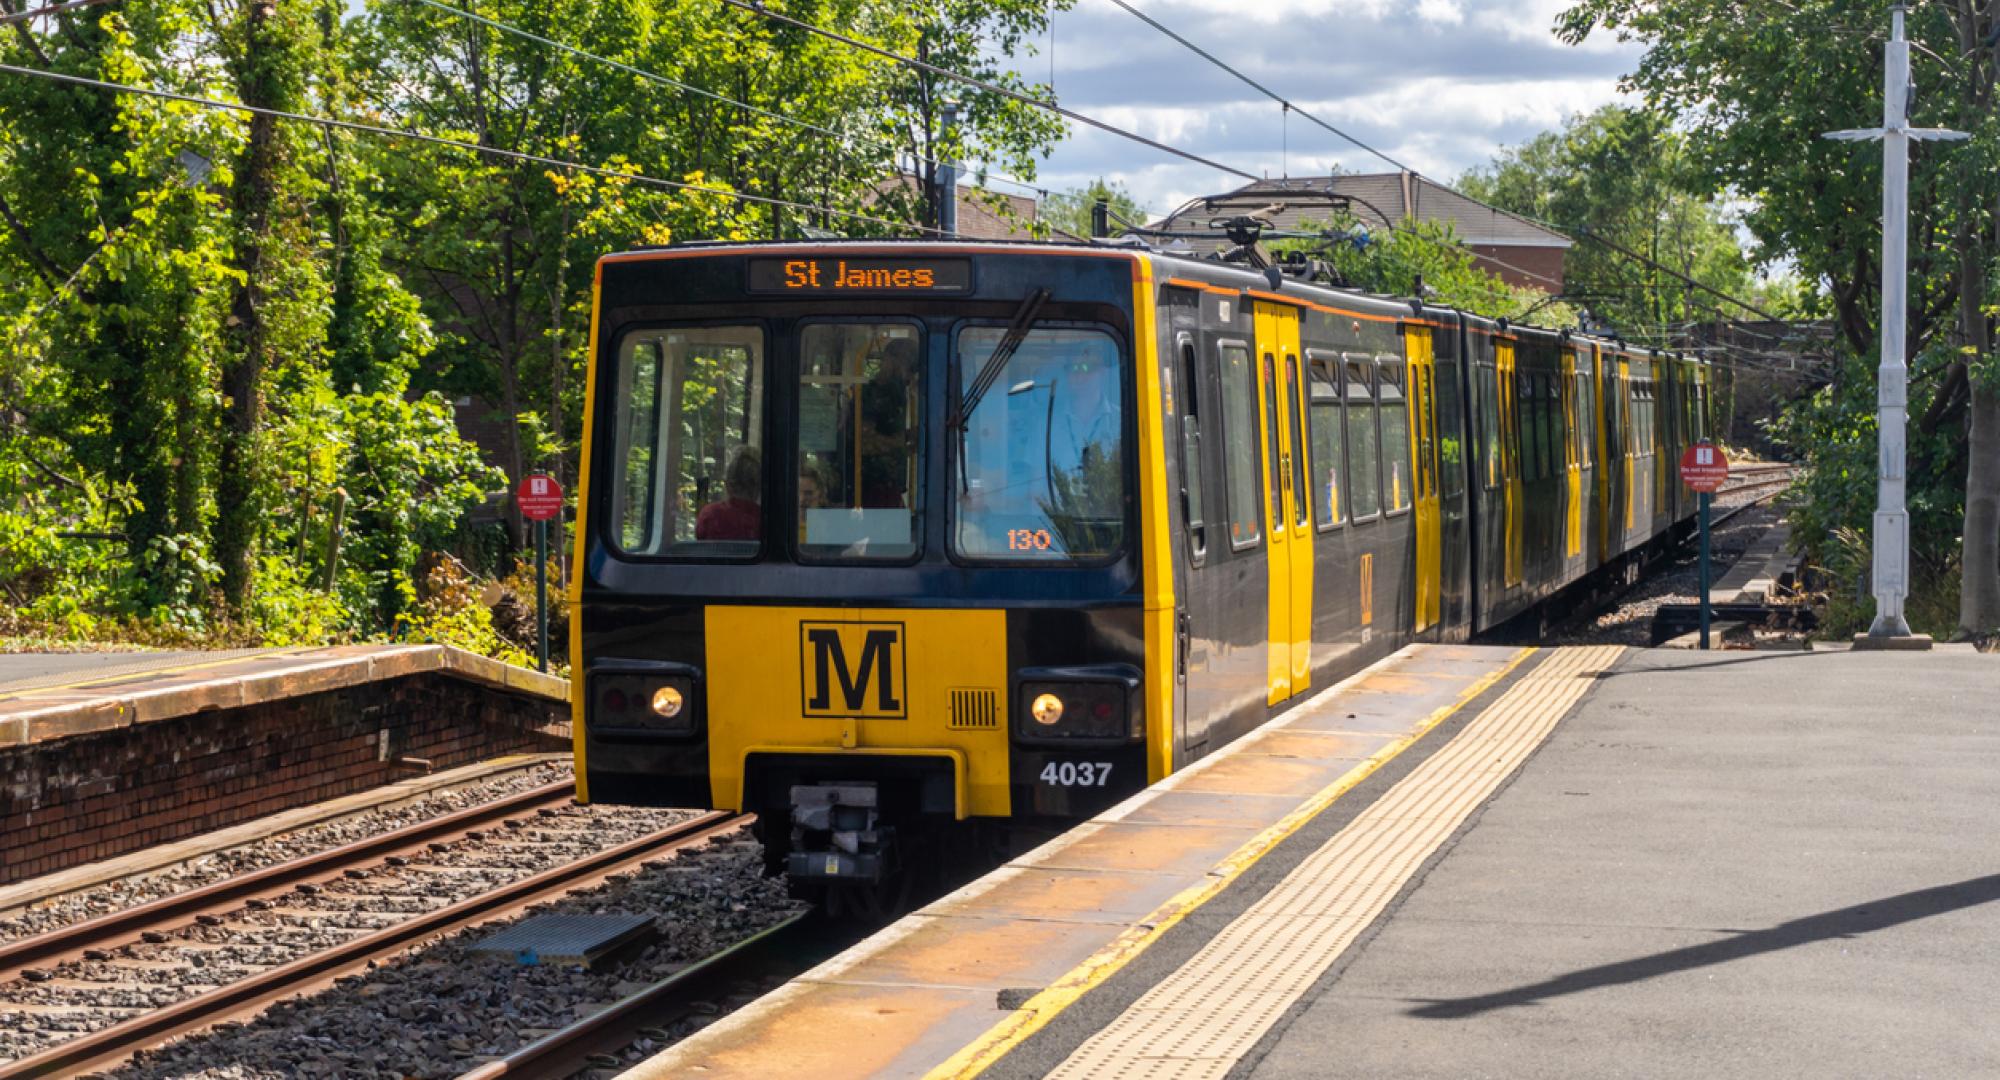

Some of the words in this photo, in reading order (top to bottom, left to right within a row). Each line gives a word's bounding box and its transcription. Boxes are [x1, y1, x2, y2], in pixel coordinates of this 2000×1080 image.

[784, 261, 820, 287] St
[834, 261, 934, 287] James
[1008, 529, 1051, 550] 130
[808, 628, 900, 711] M
[1040, 762, 1113, 786] 4037
